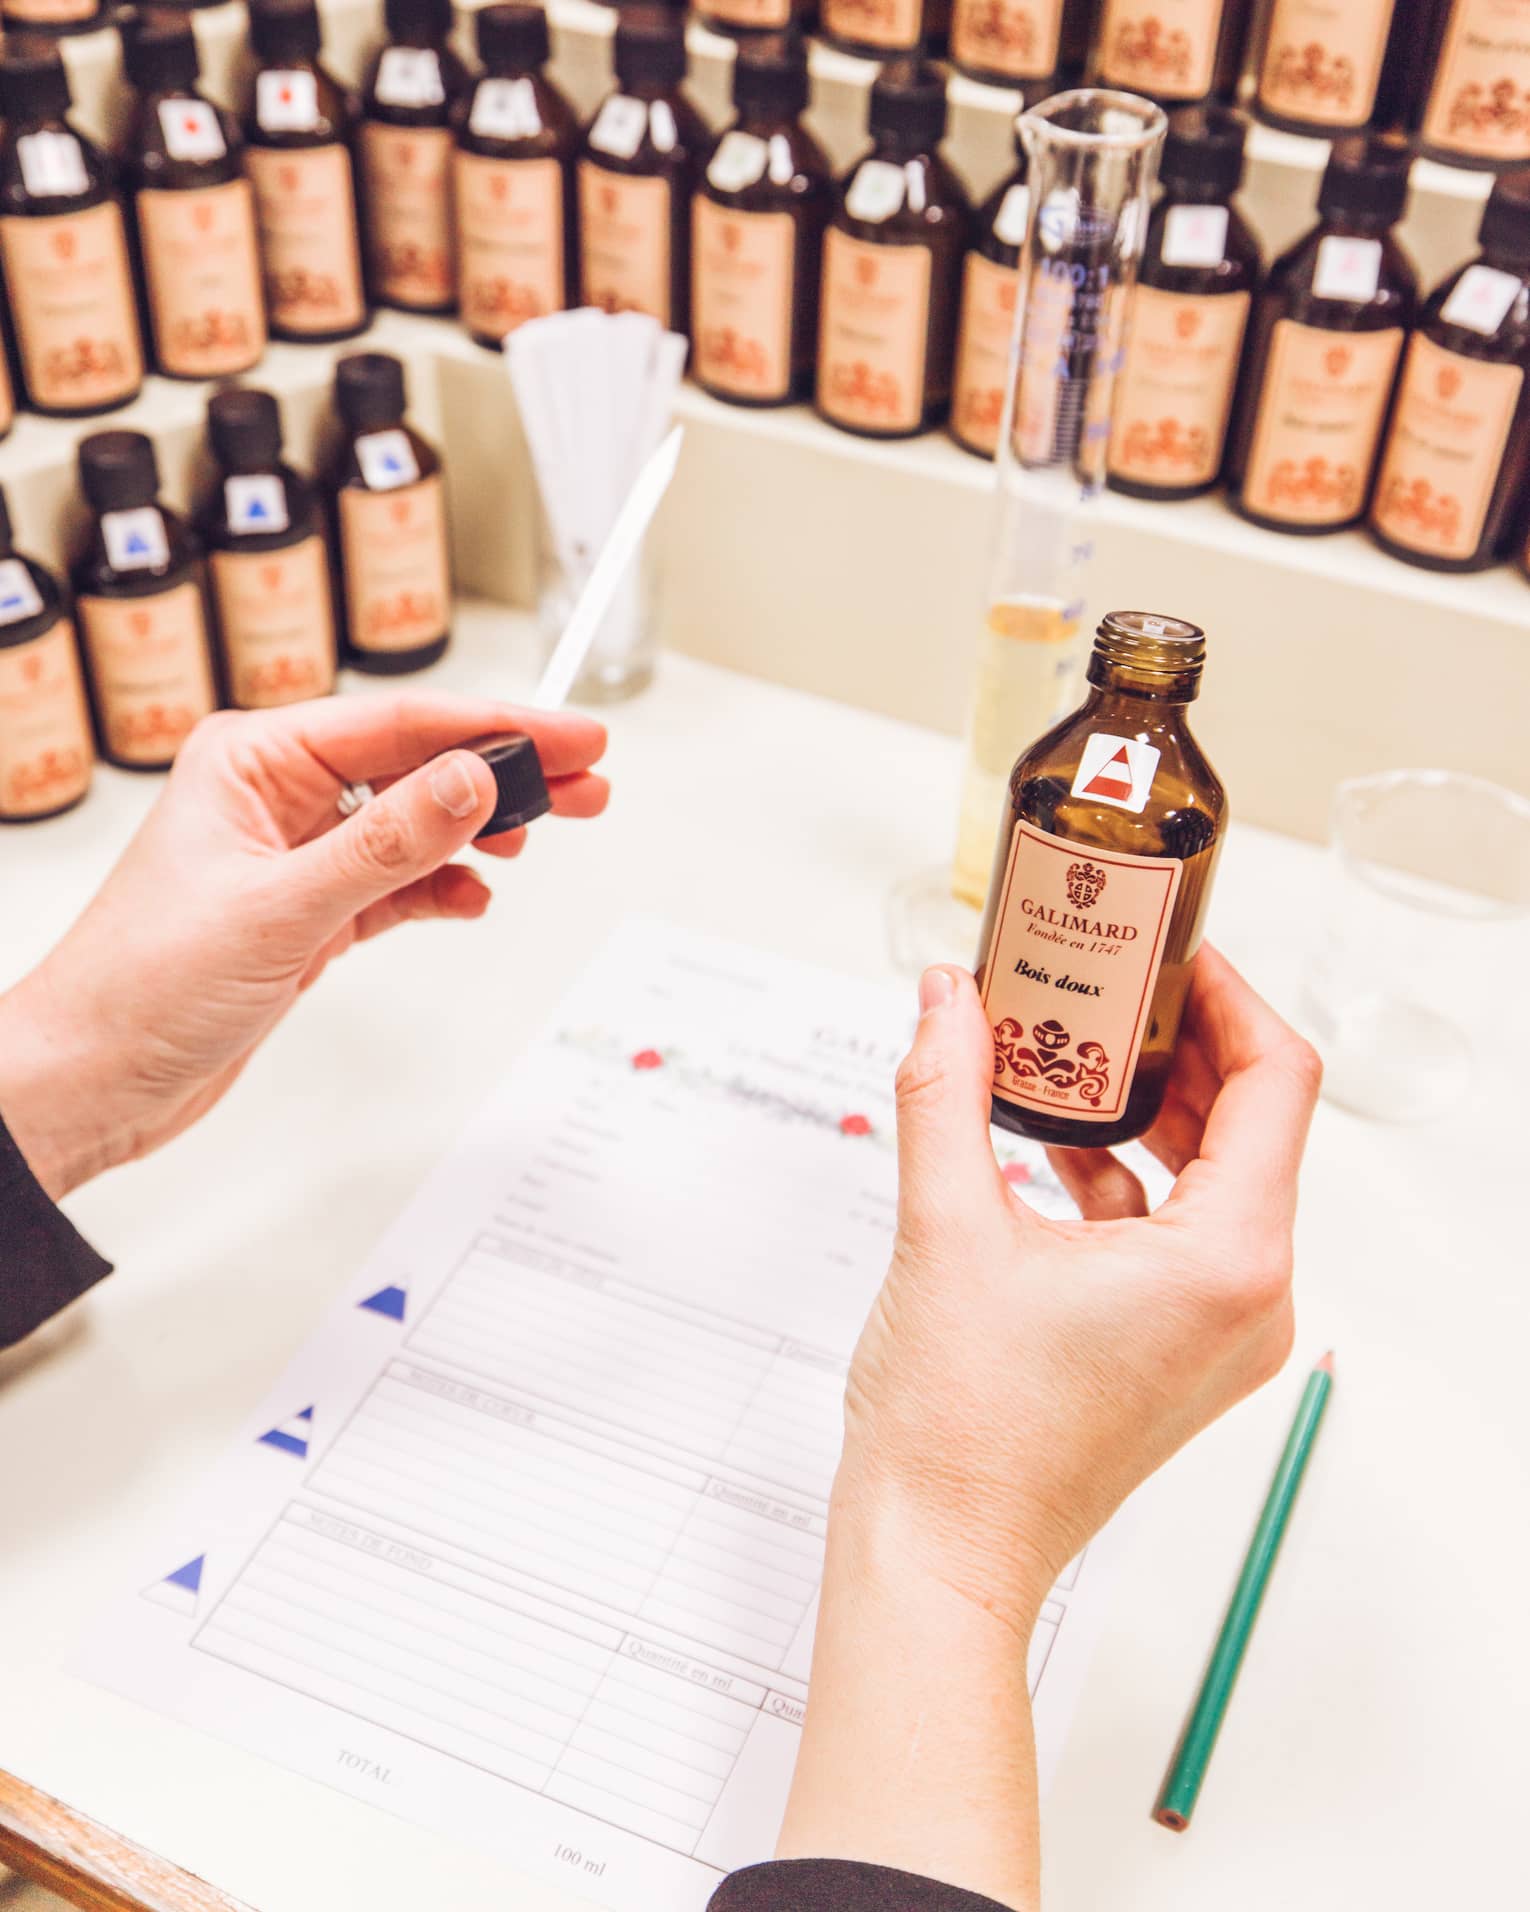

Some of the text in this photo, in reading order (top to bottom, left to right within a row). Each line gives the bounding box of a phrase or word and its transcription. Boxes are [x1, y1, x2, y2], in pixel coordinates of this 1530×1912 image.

[1021, 898, 1138, 941] GALIMARD
[1026, 922, 1122, 956] Fondée en 1747
[1014, 958, 1104, 997] Bois doux
[1012, 1075, 1037, 1091] Grasse
[1043, 1085, 1070, 1100] France
[629, 1641, 734, 1692] Quantité en ml
[337, 1749, 392, 1785] TOTAL
[553, 1843, 607, 1877] 100 ml
